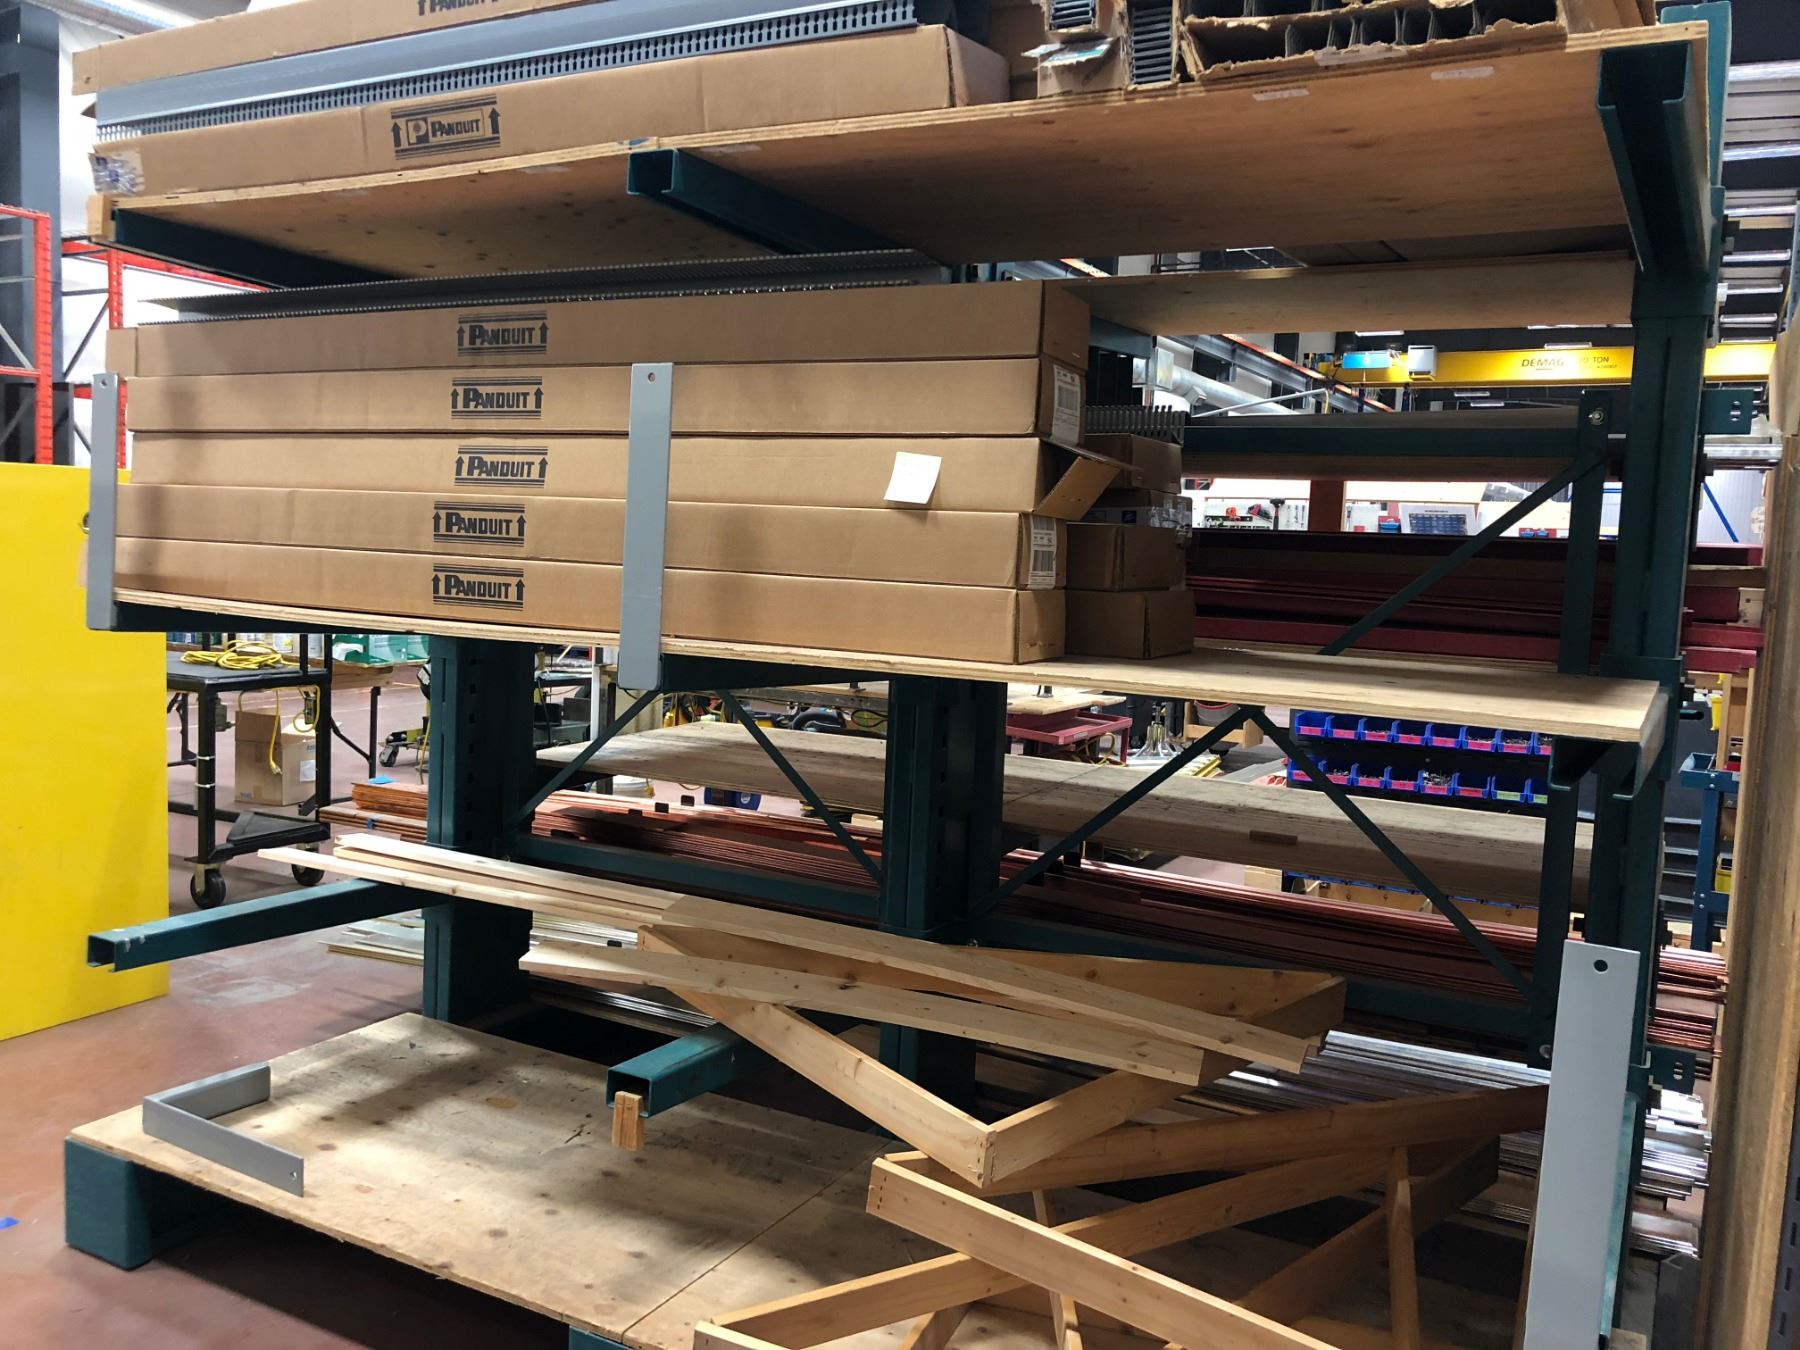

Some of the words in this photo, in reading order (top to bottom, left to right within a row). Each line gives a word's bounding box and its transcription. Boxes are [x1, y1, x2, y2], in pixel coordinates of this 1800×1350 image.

[430, 0, 485, 13] PAND
[431, 119, 481, 138] PANDUIT
[469, 324, 535, 346] PANDUIT
[1521, 358, 1565, 367] DEMAG
[1592, 356, 1609, 364] TON
[463, 387, 530, 409] PANDUIT
[467, 455, 535, 478] PANDUIT
[445, 511, 513, 536] PANDUIT
[444, 574, 512, 599] PANDUIT
